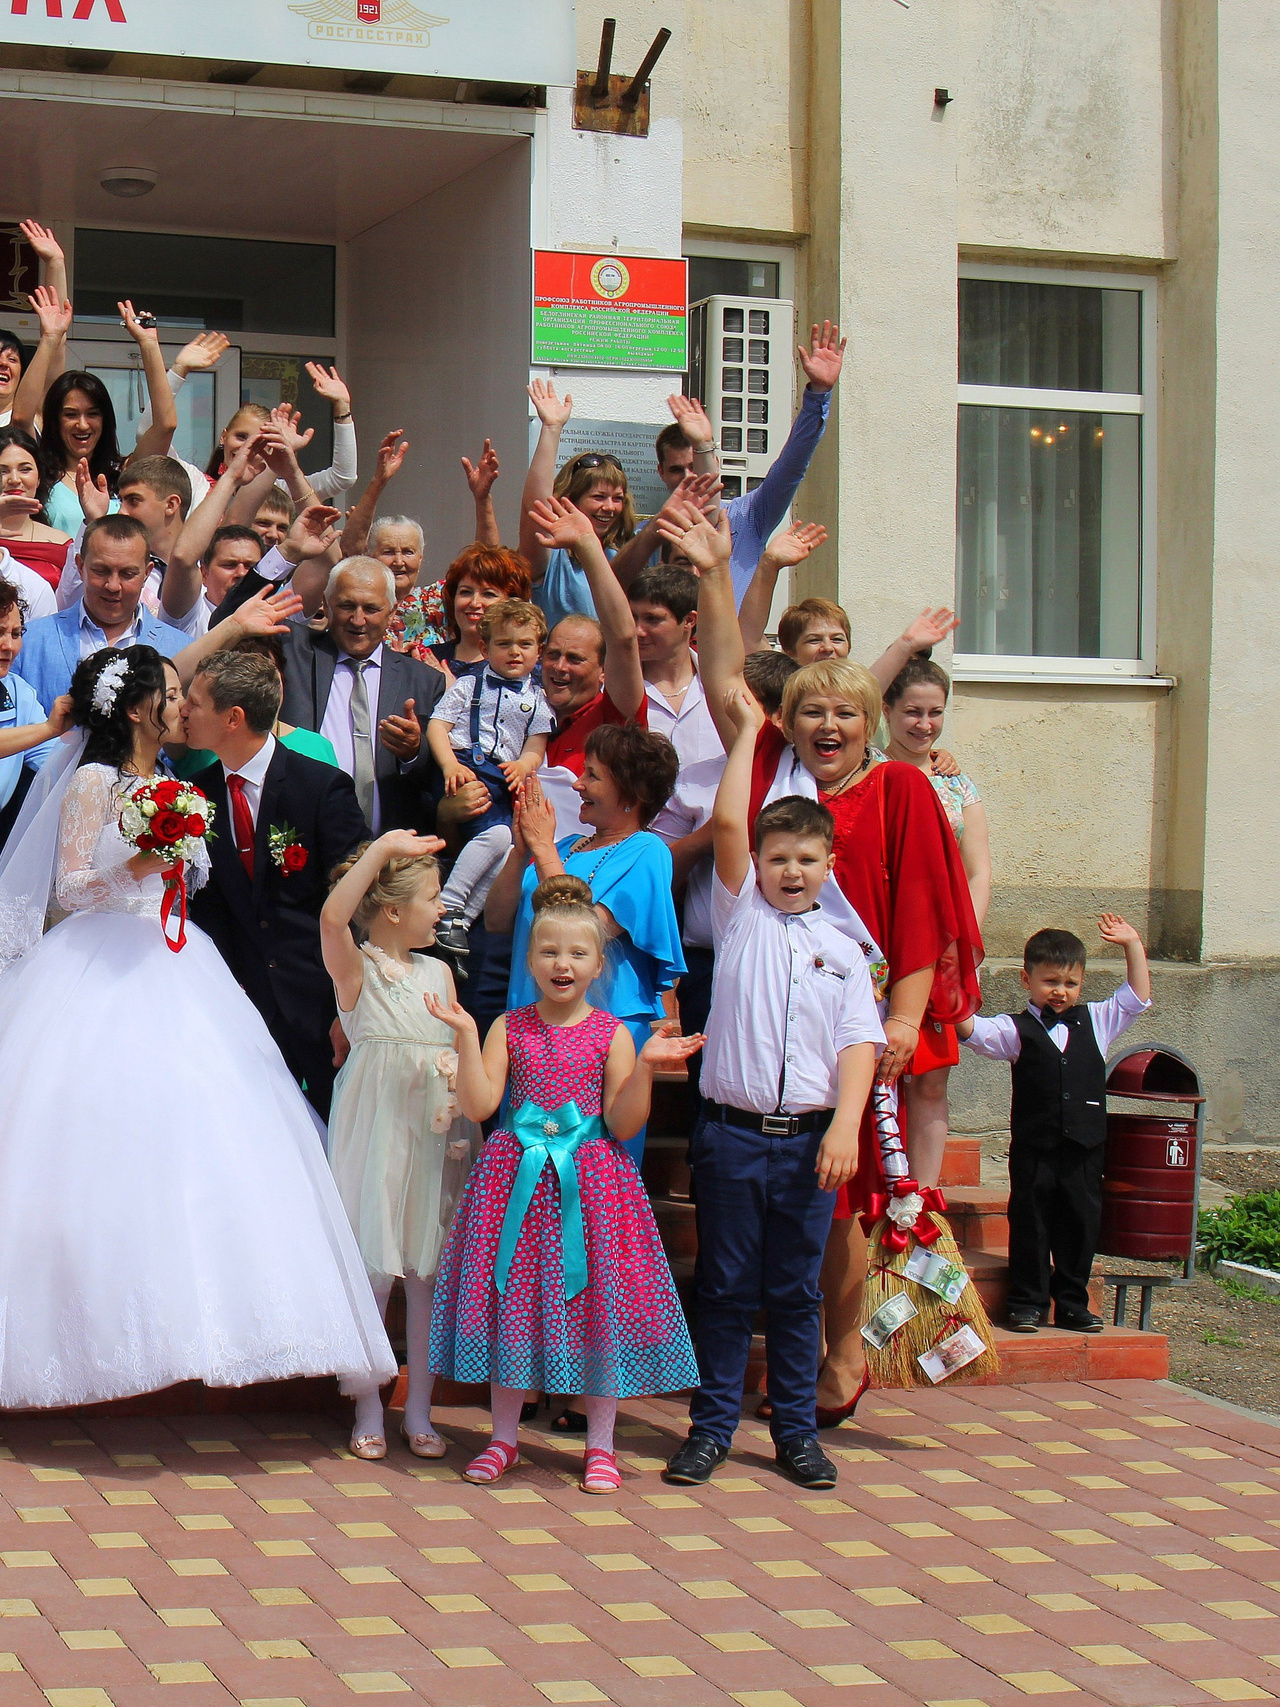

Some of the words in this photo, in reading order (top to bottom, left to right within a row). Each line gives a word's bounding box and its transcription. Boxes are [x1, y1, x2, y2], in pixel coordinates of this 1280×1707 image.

[359, 4, 378, 14] 1921
[316, 25, 423, 43] РОСГОССТРАХ
[571, 298, 612, 306] РАБОТНИКОВ
[614, 301, 685, 311] АГРОПРОМЫШЛЕННОГО
[627, 441, 657, 449] КАРТОГРА
